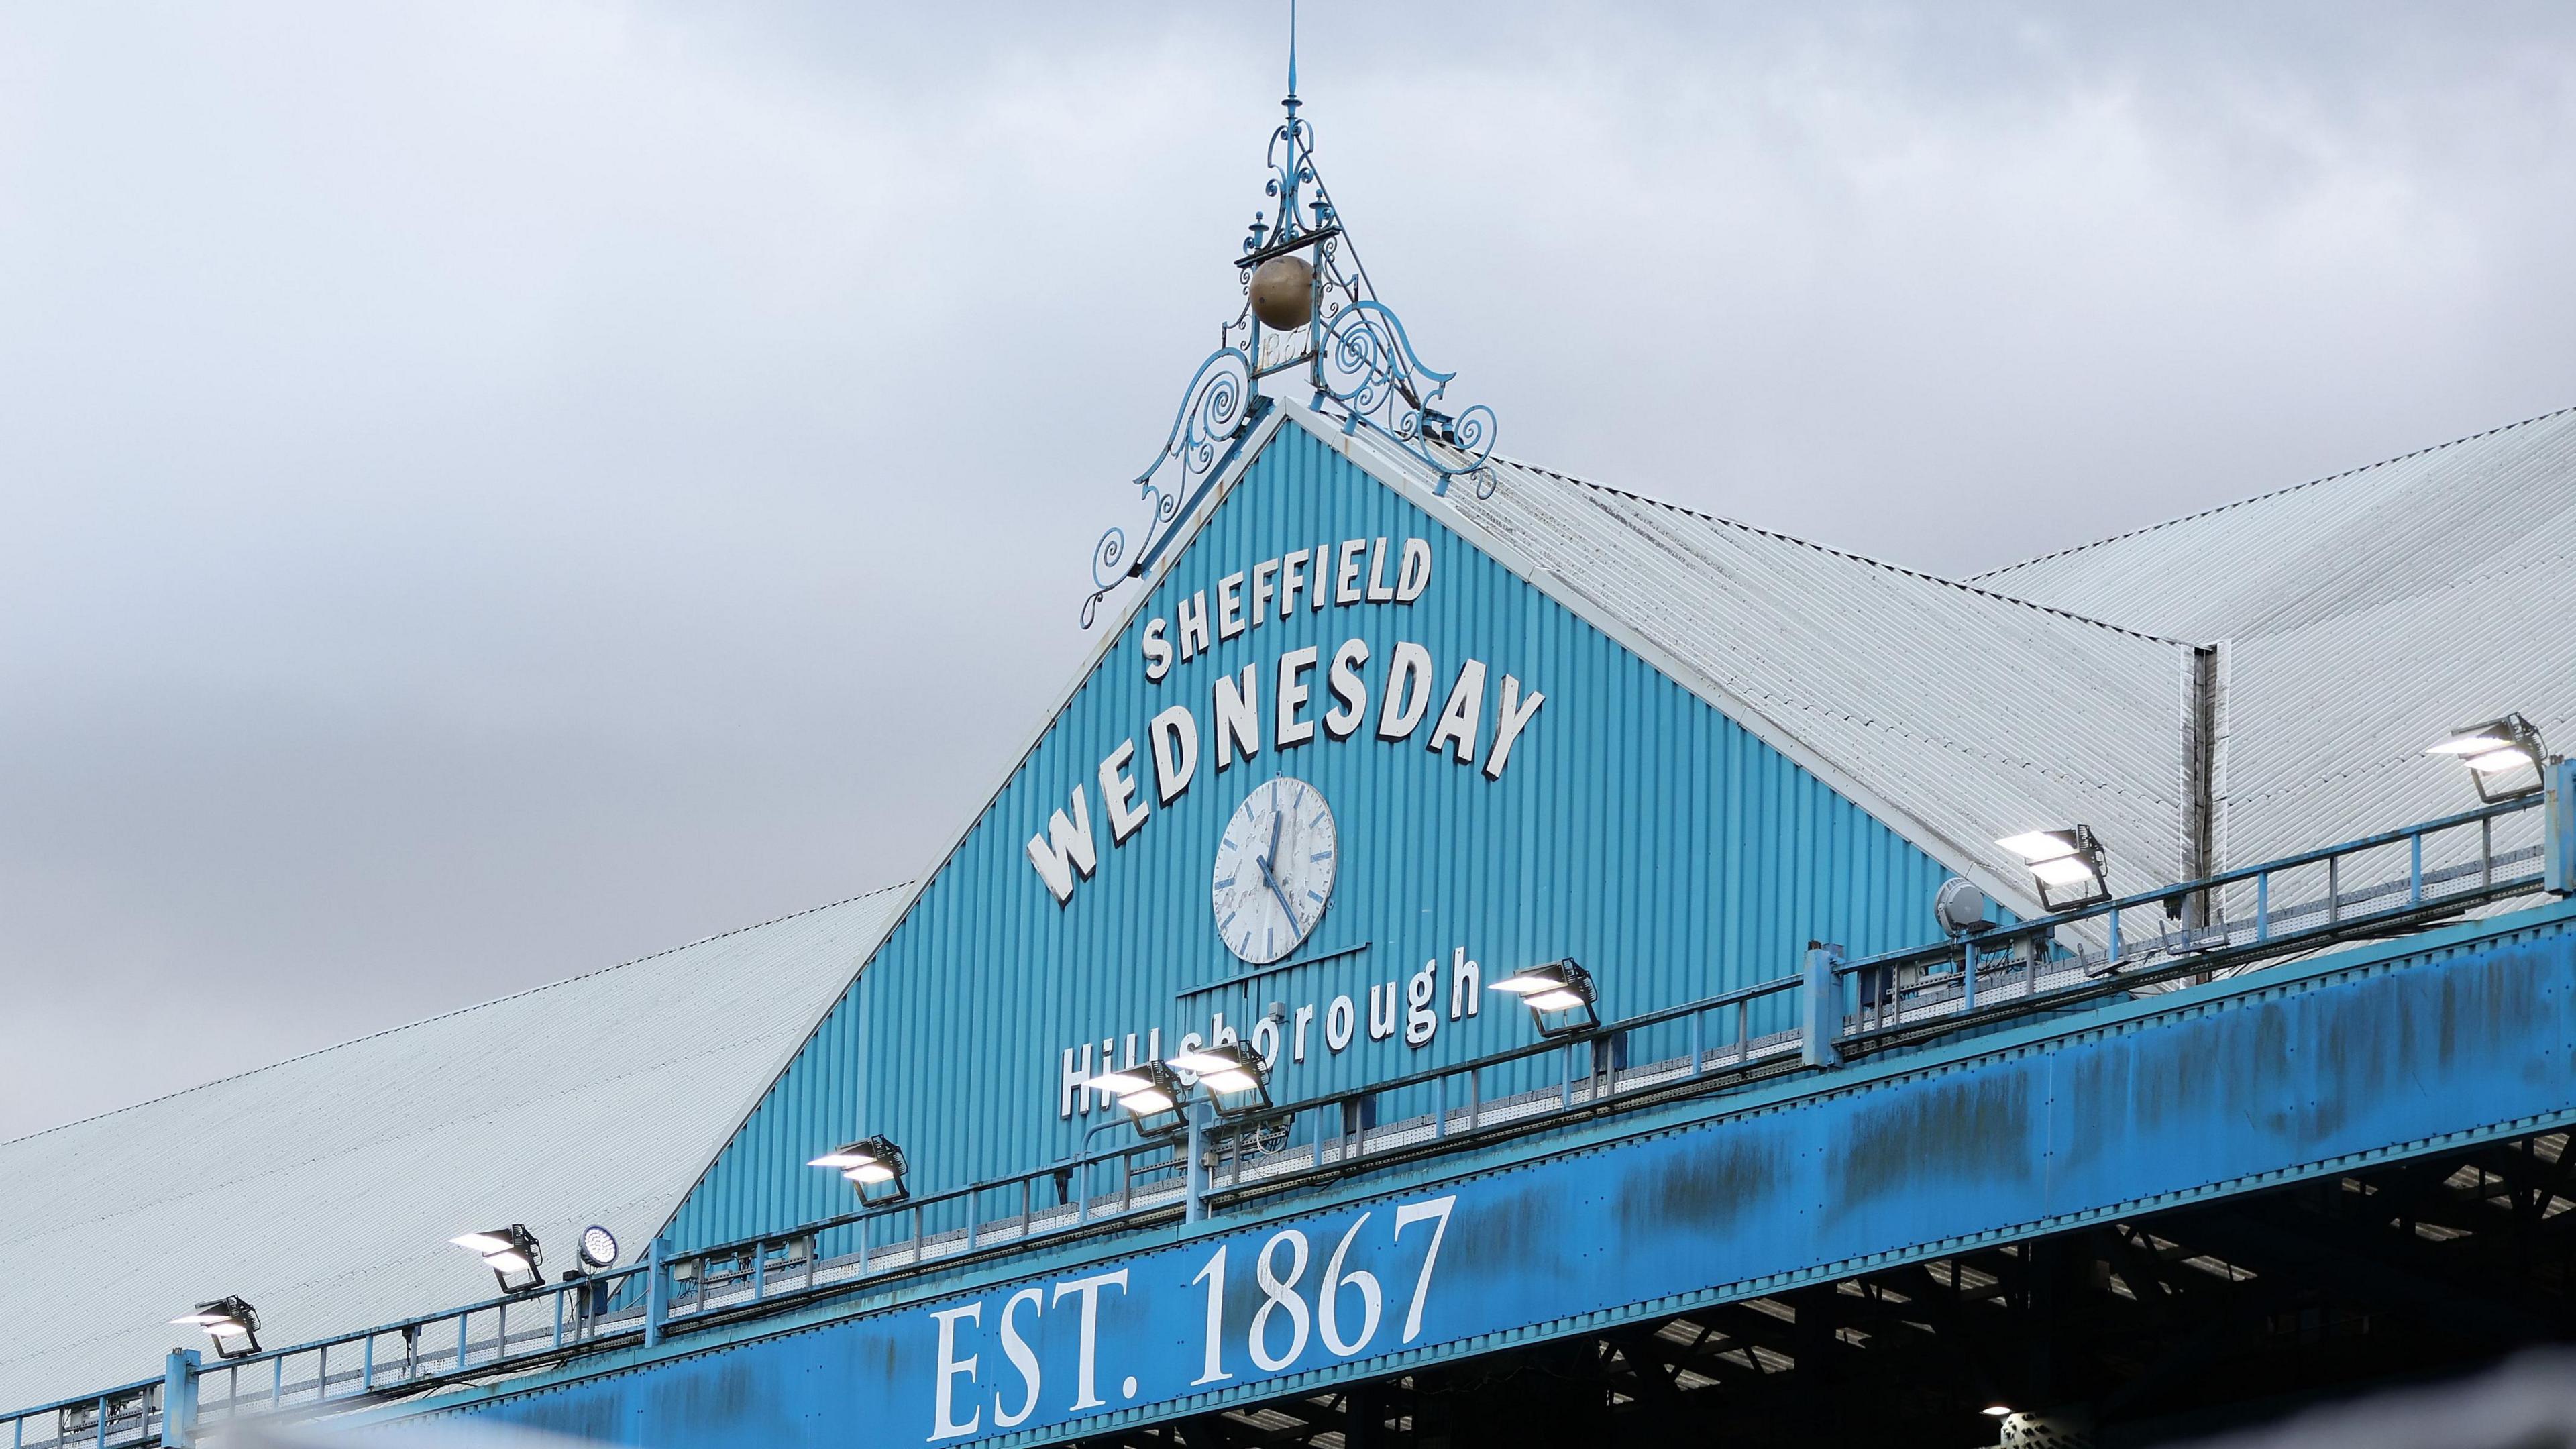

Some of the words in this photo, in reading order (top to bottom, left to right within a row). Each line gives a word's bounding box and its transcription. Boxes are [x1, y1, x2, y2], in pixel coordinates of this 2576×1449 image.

[1141, 537, 1432, 682] SHEFFIELD
[1026, 638, 1546, 907] WEDNESDAY
[926, 1268, 1138, 1442] EST.
[1191, 1195, 1456, 1387] 1867
